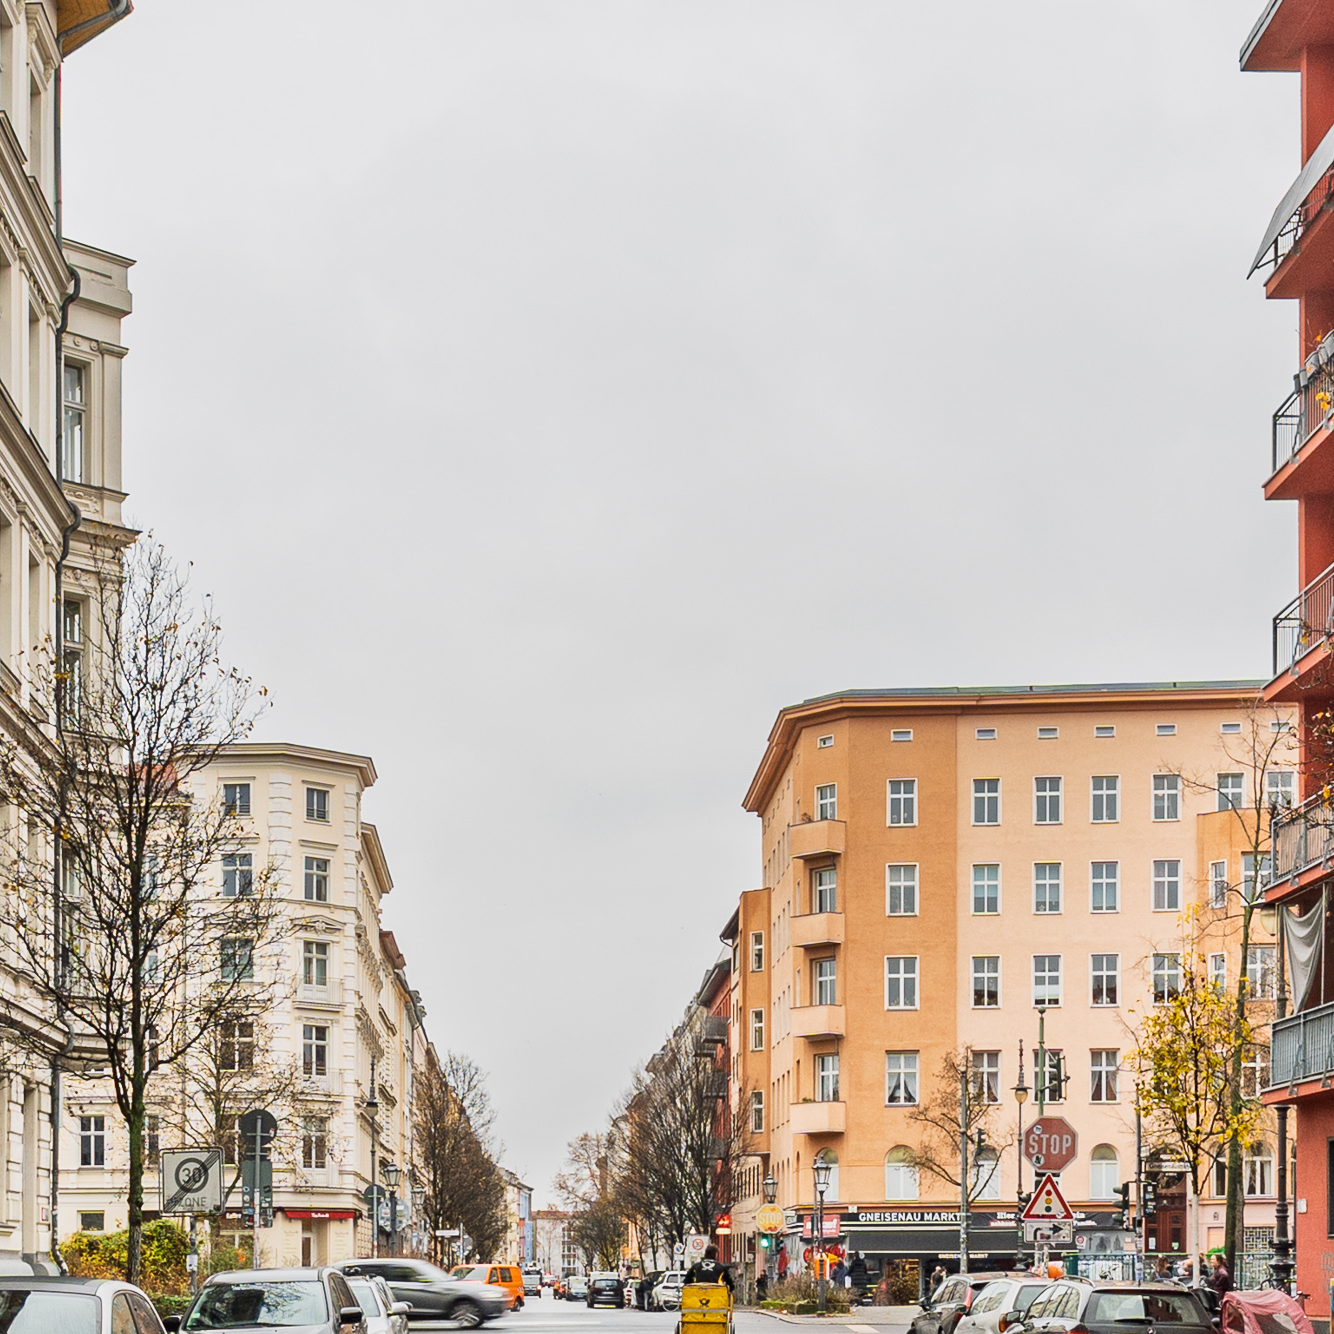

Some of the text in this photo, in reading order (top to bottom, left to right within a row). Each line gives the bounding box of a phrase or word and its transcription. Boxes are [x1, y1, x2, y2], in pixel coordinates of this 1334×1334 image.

[1029, 1134, 1072, 1155] STOP
[182, 1168, 202, 1183] 30
[759, 1212, 782, 1225] STOP
[858, 1212, 961, 1222] GNEISENAU MARKT
